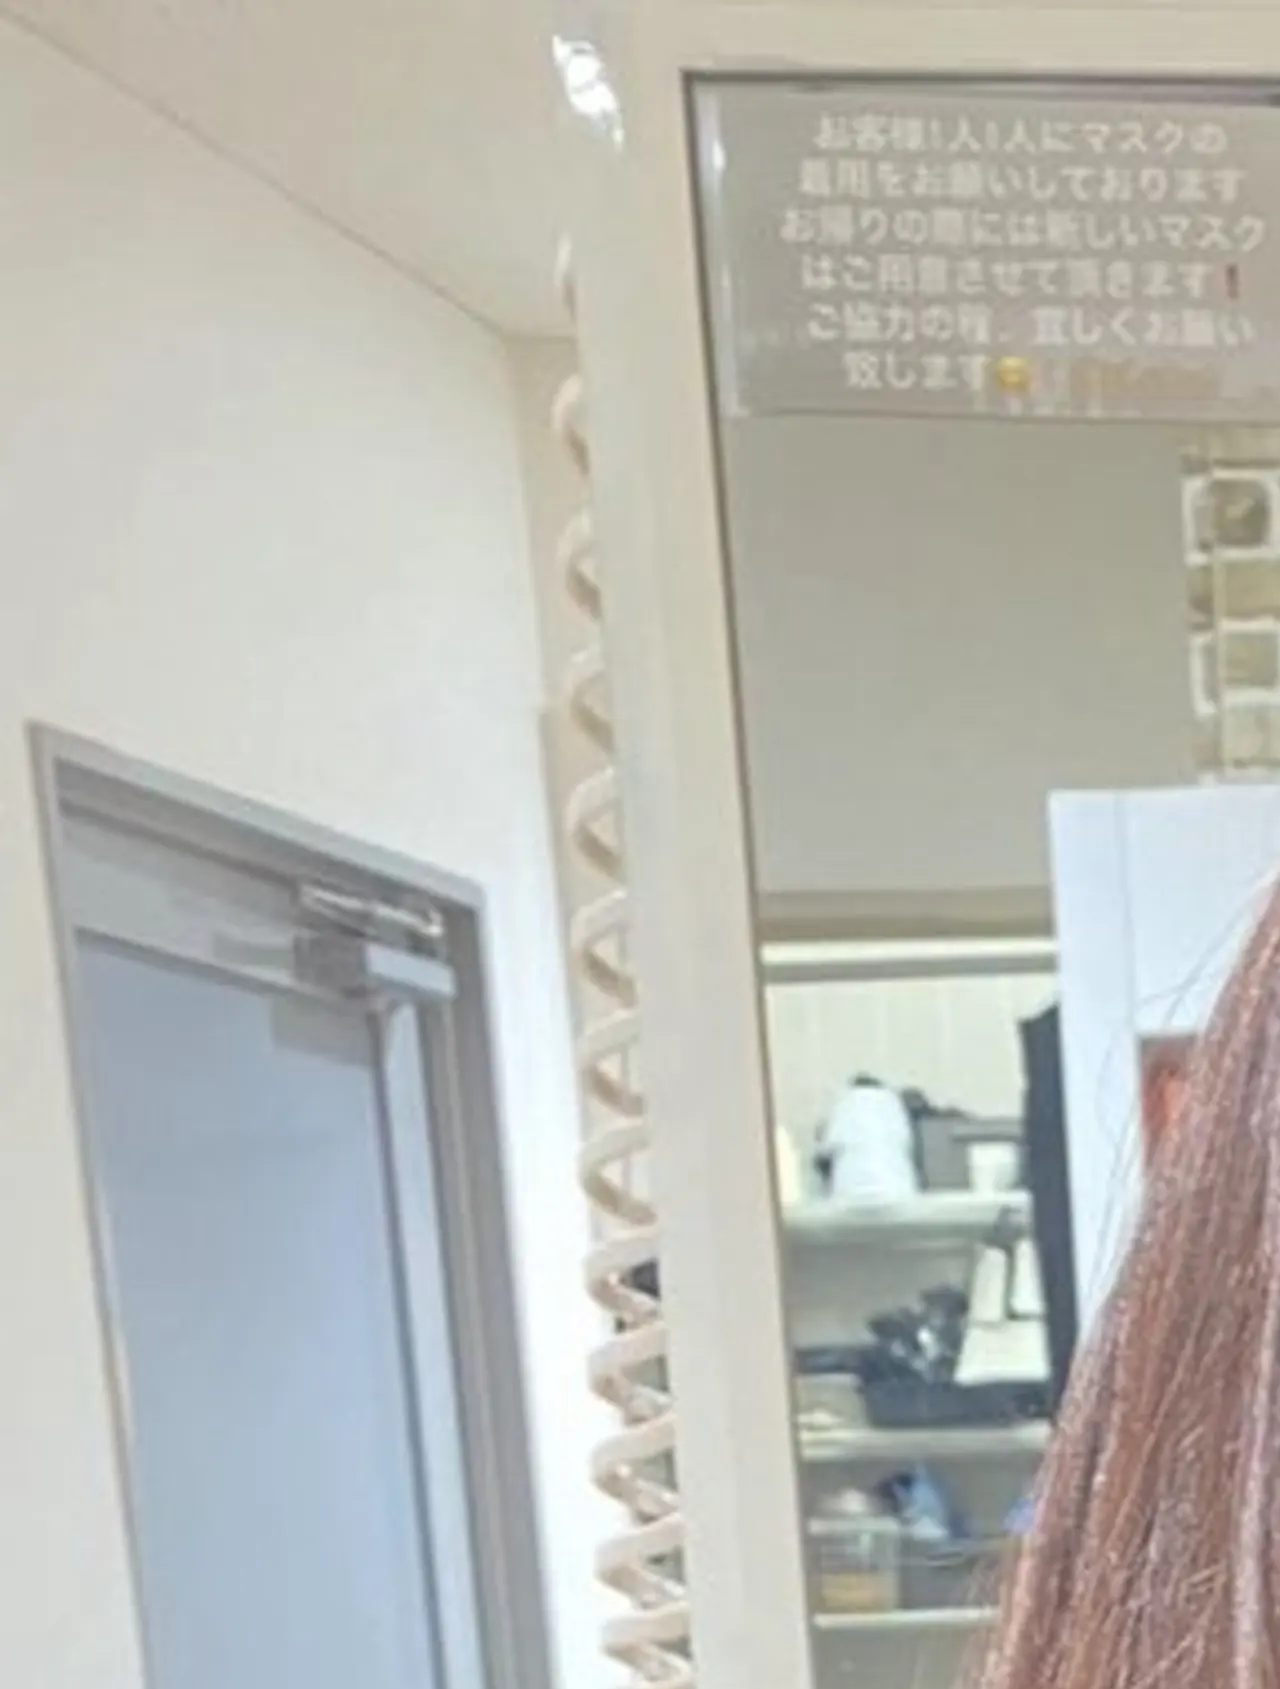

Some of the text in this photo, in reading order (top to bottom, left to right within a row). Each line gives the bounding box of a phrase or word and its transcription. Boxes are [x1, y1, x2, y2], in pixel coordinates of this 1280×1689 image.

[800, 158, 1247, 203] 用をおいしております
[780, 204, 1266, 251] おりのには新しいマスク
[807, 301, 1257, 347] ご協力の程、宜しくおい
